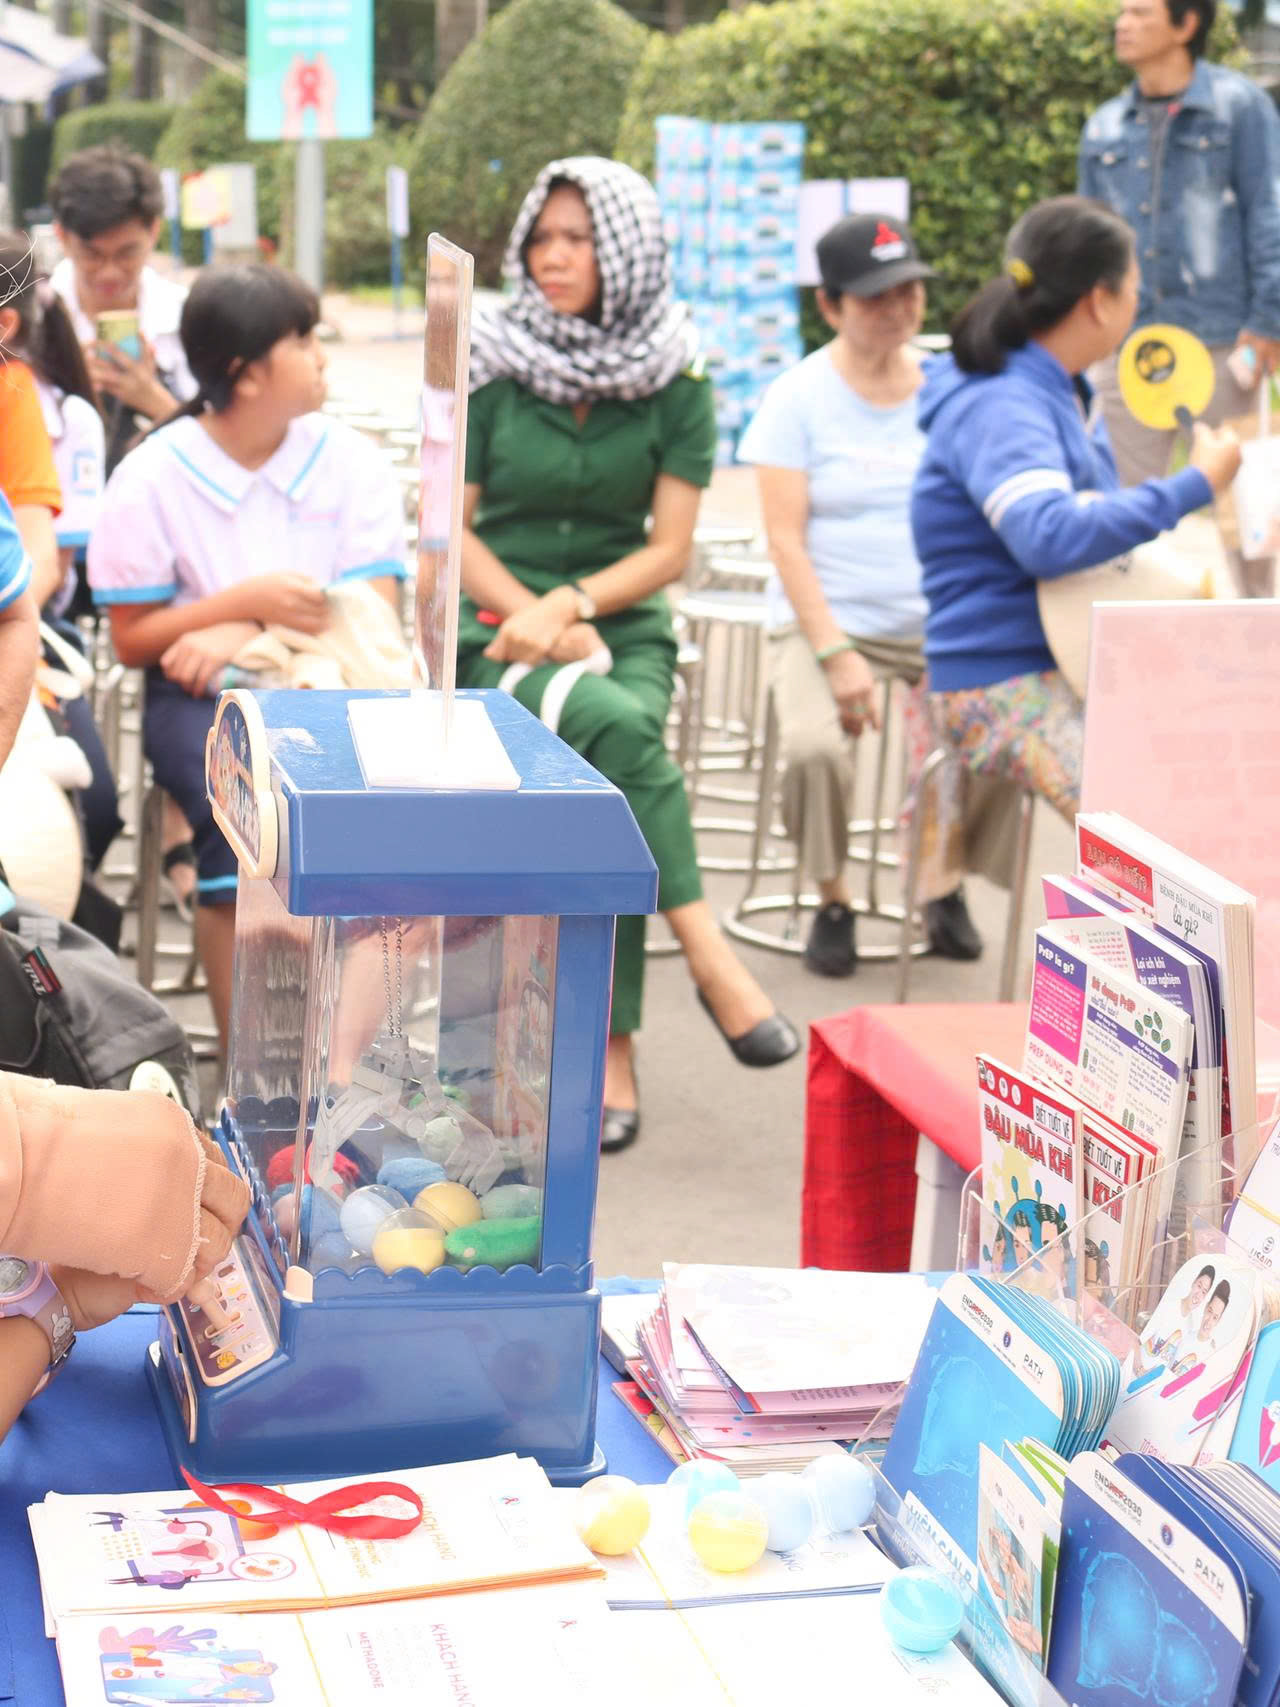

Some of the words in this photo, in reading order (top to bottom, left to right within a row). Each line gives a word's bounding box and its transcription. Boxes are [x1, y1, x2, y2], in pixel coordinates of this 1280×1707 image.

[1155, 956, 1166, 969] khi
[984, 1103, 1011, 1143] ĐẬU
[1014, 1123, 1046, 1167] MÙA
[1048, 1143, 1073, 1184] KHỈ
[1023, 1353, 1044, 1378] PATH
[1195, 1557, 1225, 1592] PATH
[358, 1632, 385, 1689] METHADONE
